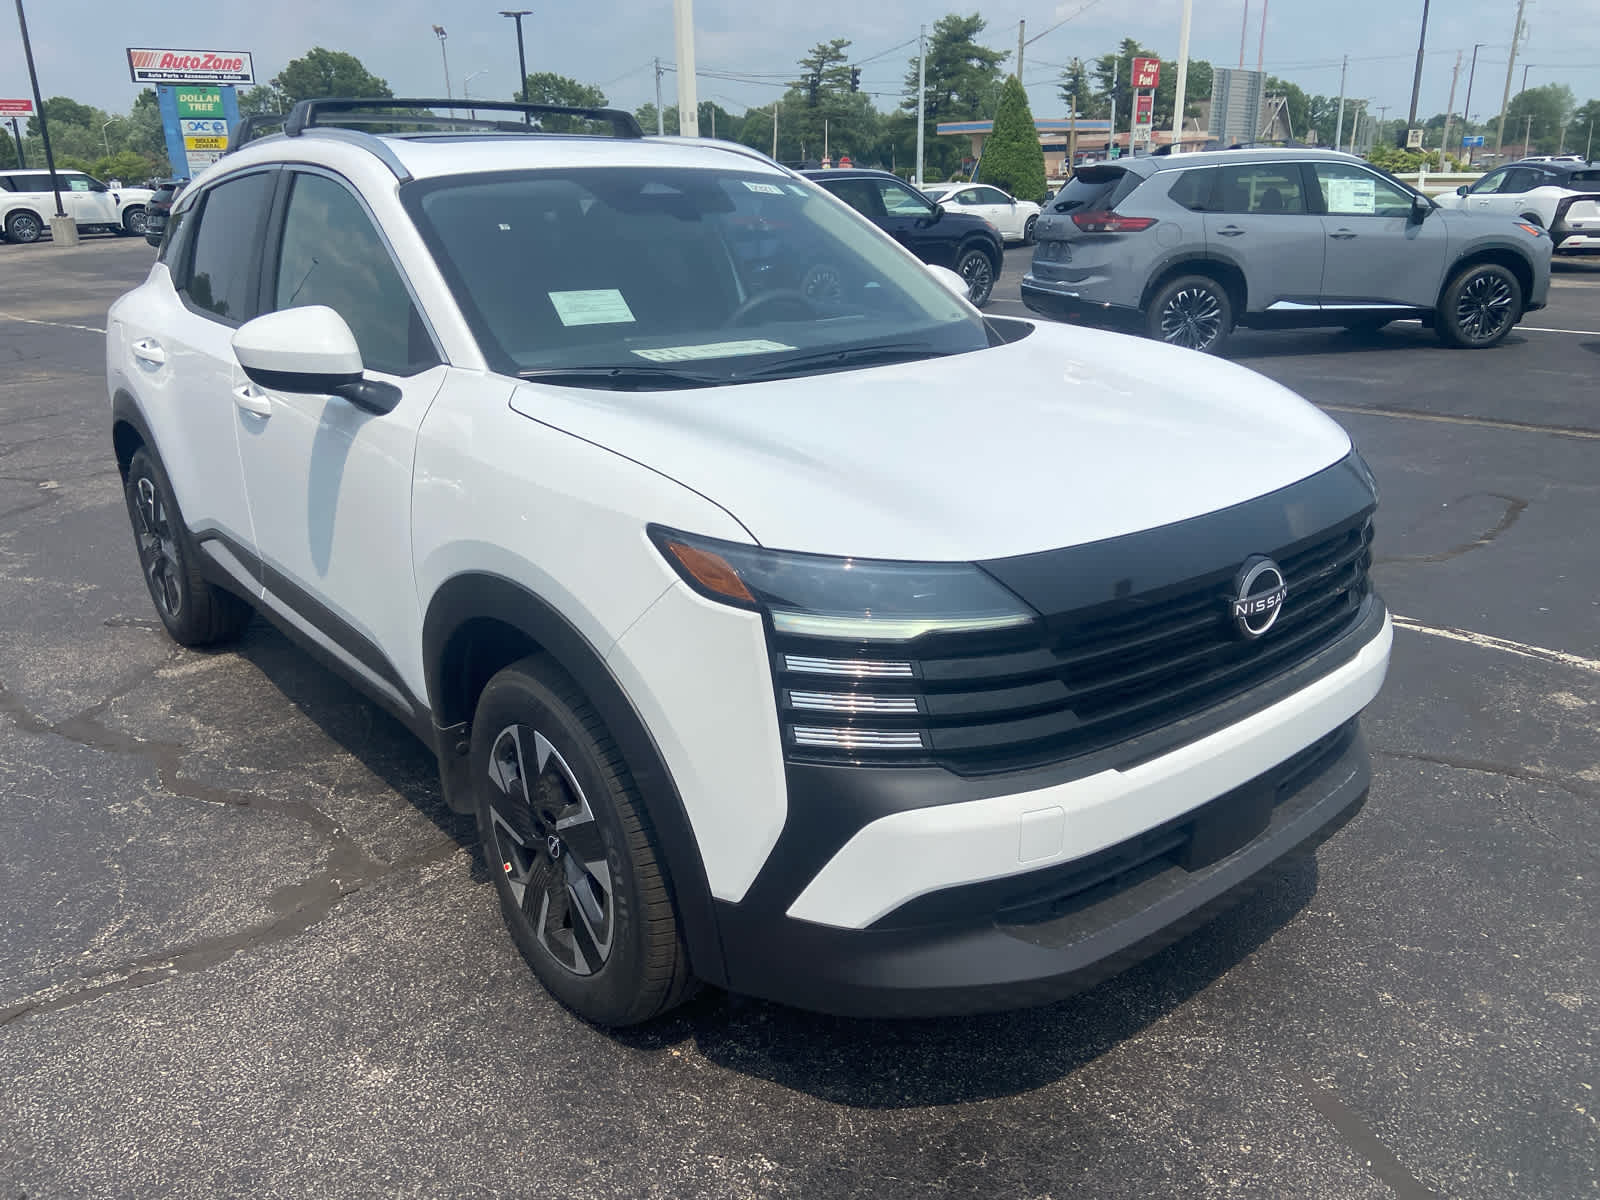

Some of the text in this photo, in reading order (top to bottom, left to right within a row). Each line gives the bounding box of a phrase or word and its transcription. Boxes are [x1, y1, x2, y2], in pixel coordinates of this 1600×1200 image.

[160, 53, 242, 71] AutoZone
[1144, 61, 1158, 72] Fast
[1138, 74, 1153, 85] Fuel
[179, 94, 220, 103] DOLLAR
[188, 103, 214, 111] TREE
[1236, 588, 1287, 615] NISSAN
